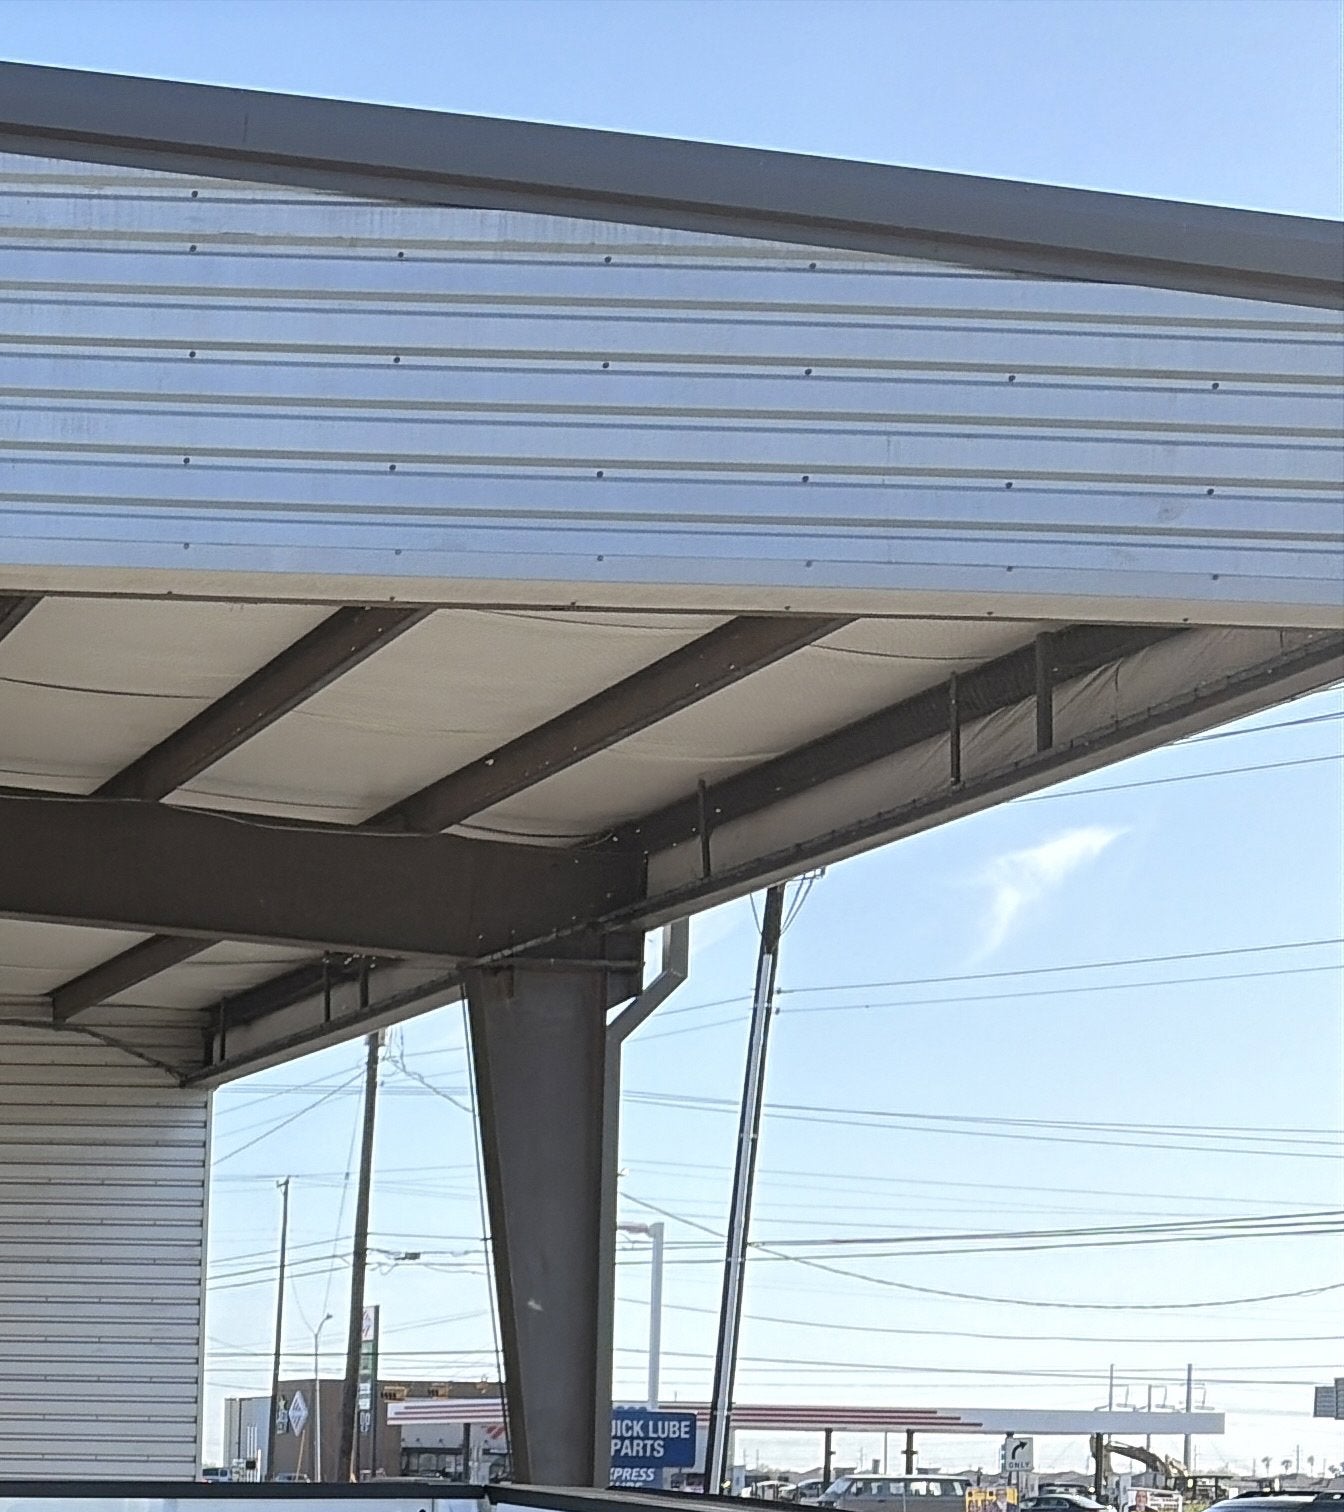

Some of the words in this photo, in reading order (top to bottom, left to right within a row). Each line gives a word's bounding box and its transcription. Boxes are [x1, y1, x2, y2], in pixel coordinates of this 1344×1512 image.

[648, 1420, 691, 1439] LUBE
[611, 1439, 665, 1457] PARTS
[1008, 1461, 1030, 1469] ONLY
